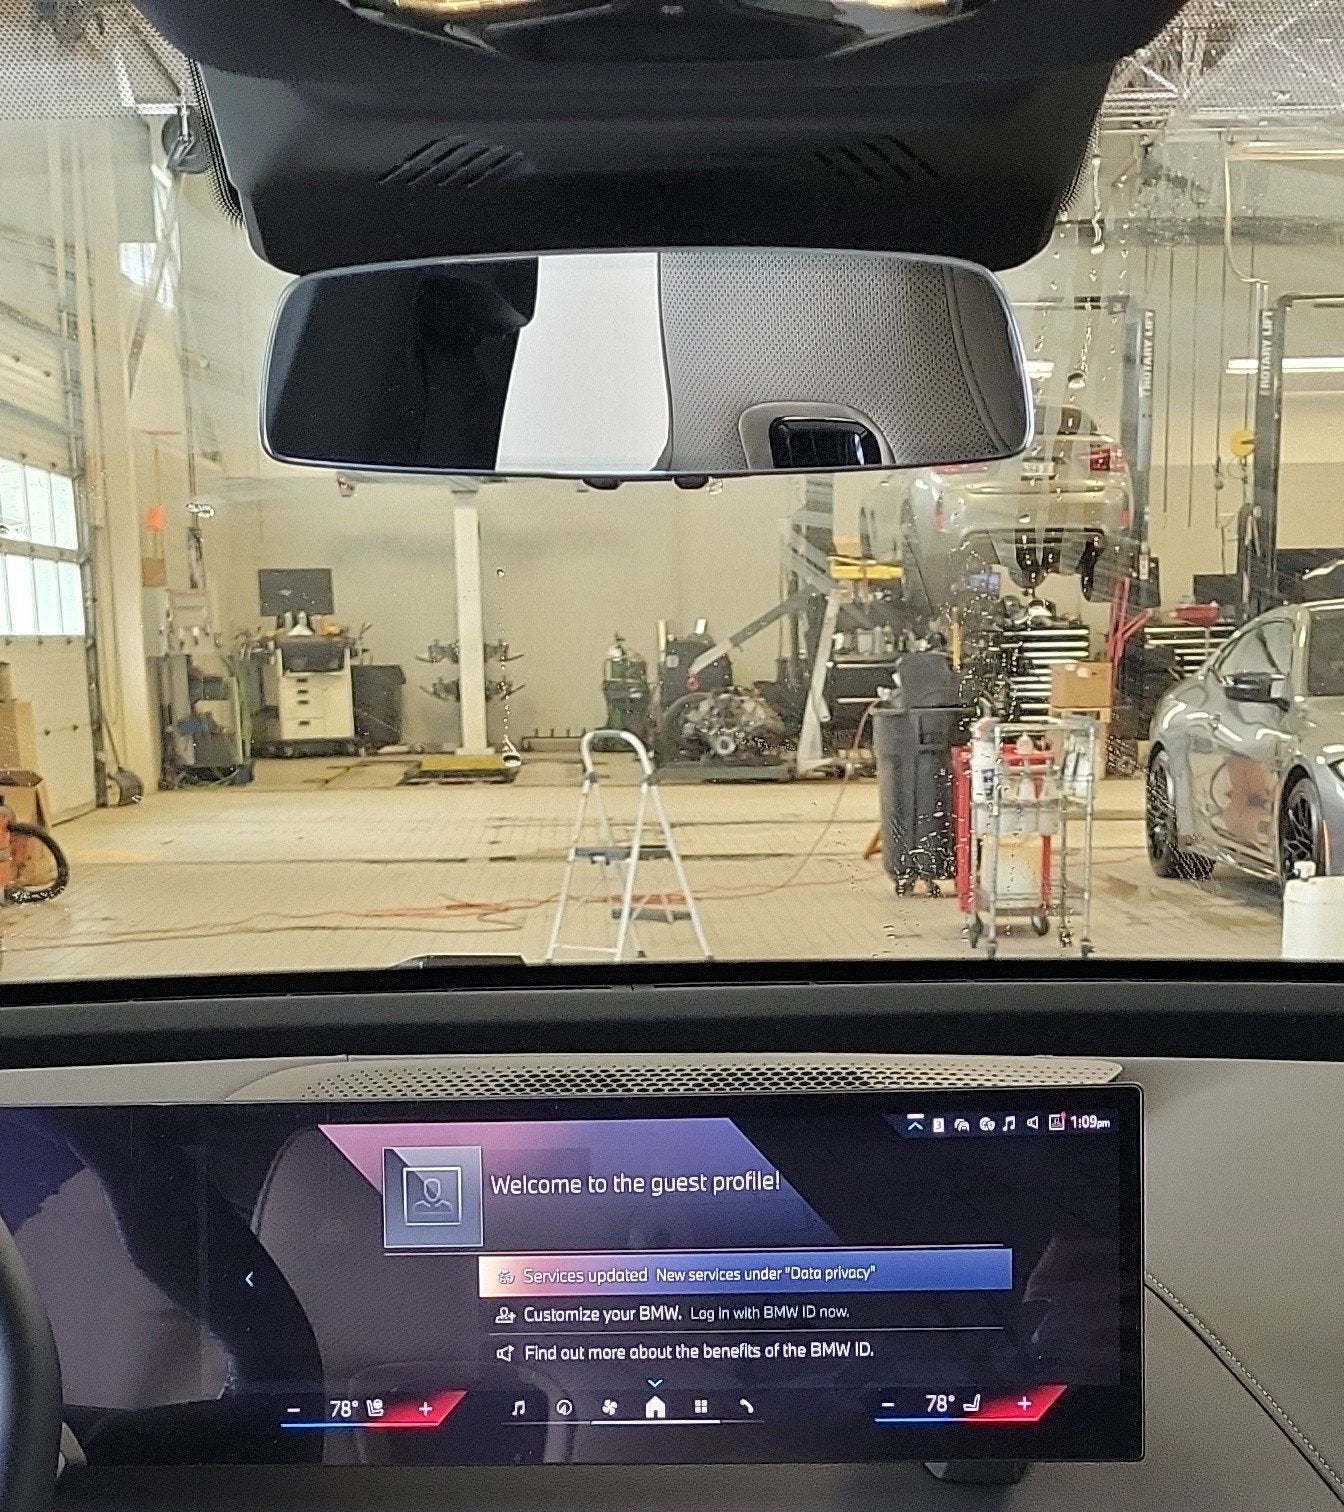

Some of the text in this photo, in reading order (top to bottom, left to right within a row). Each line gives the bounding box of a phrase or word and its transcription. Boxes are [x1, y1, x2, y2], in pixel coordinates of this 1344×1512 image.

[490, 1170, 781, 1197] Welcome to the guest profile!
[523, 1264, 876, 1286] Services updated New services under "Data privacy"
[523, 1304, 850, 1325] Customize your BMW. Log in with BMW ID now.
[525, 1341, 875, 1361] Find out more about the benefits of the BMW ID.
[330, 1400, 359, 1418] 78°
[925, 1394, 956, 1413] 78°
